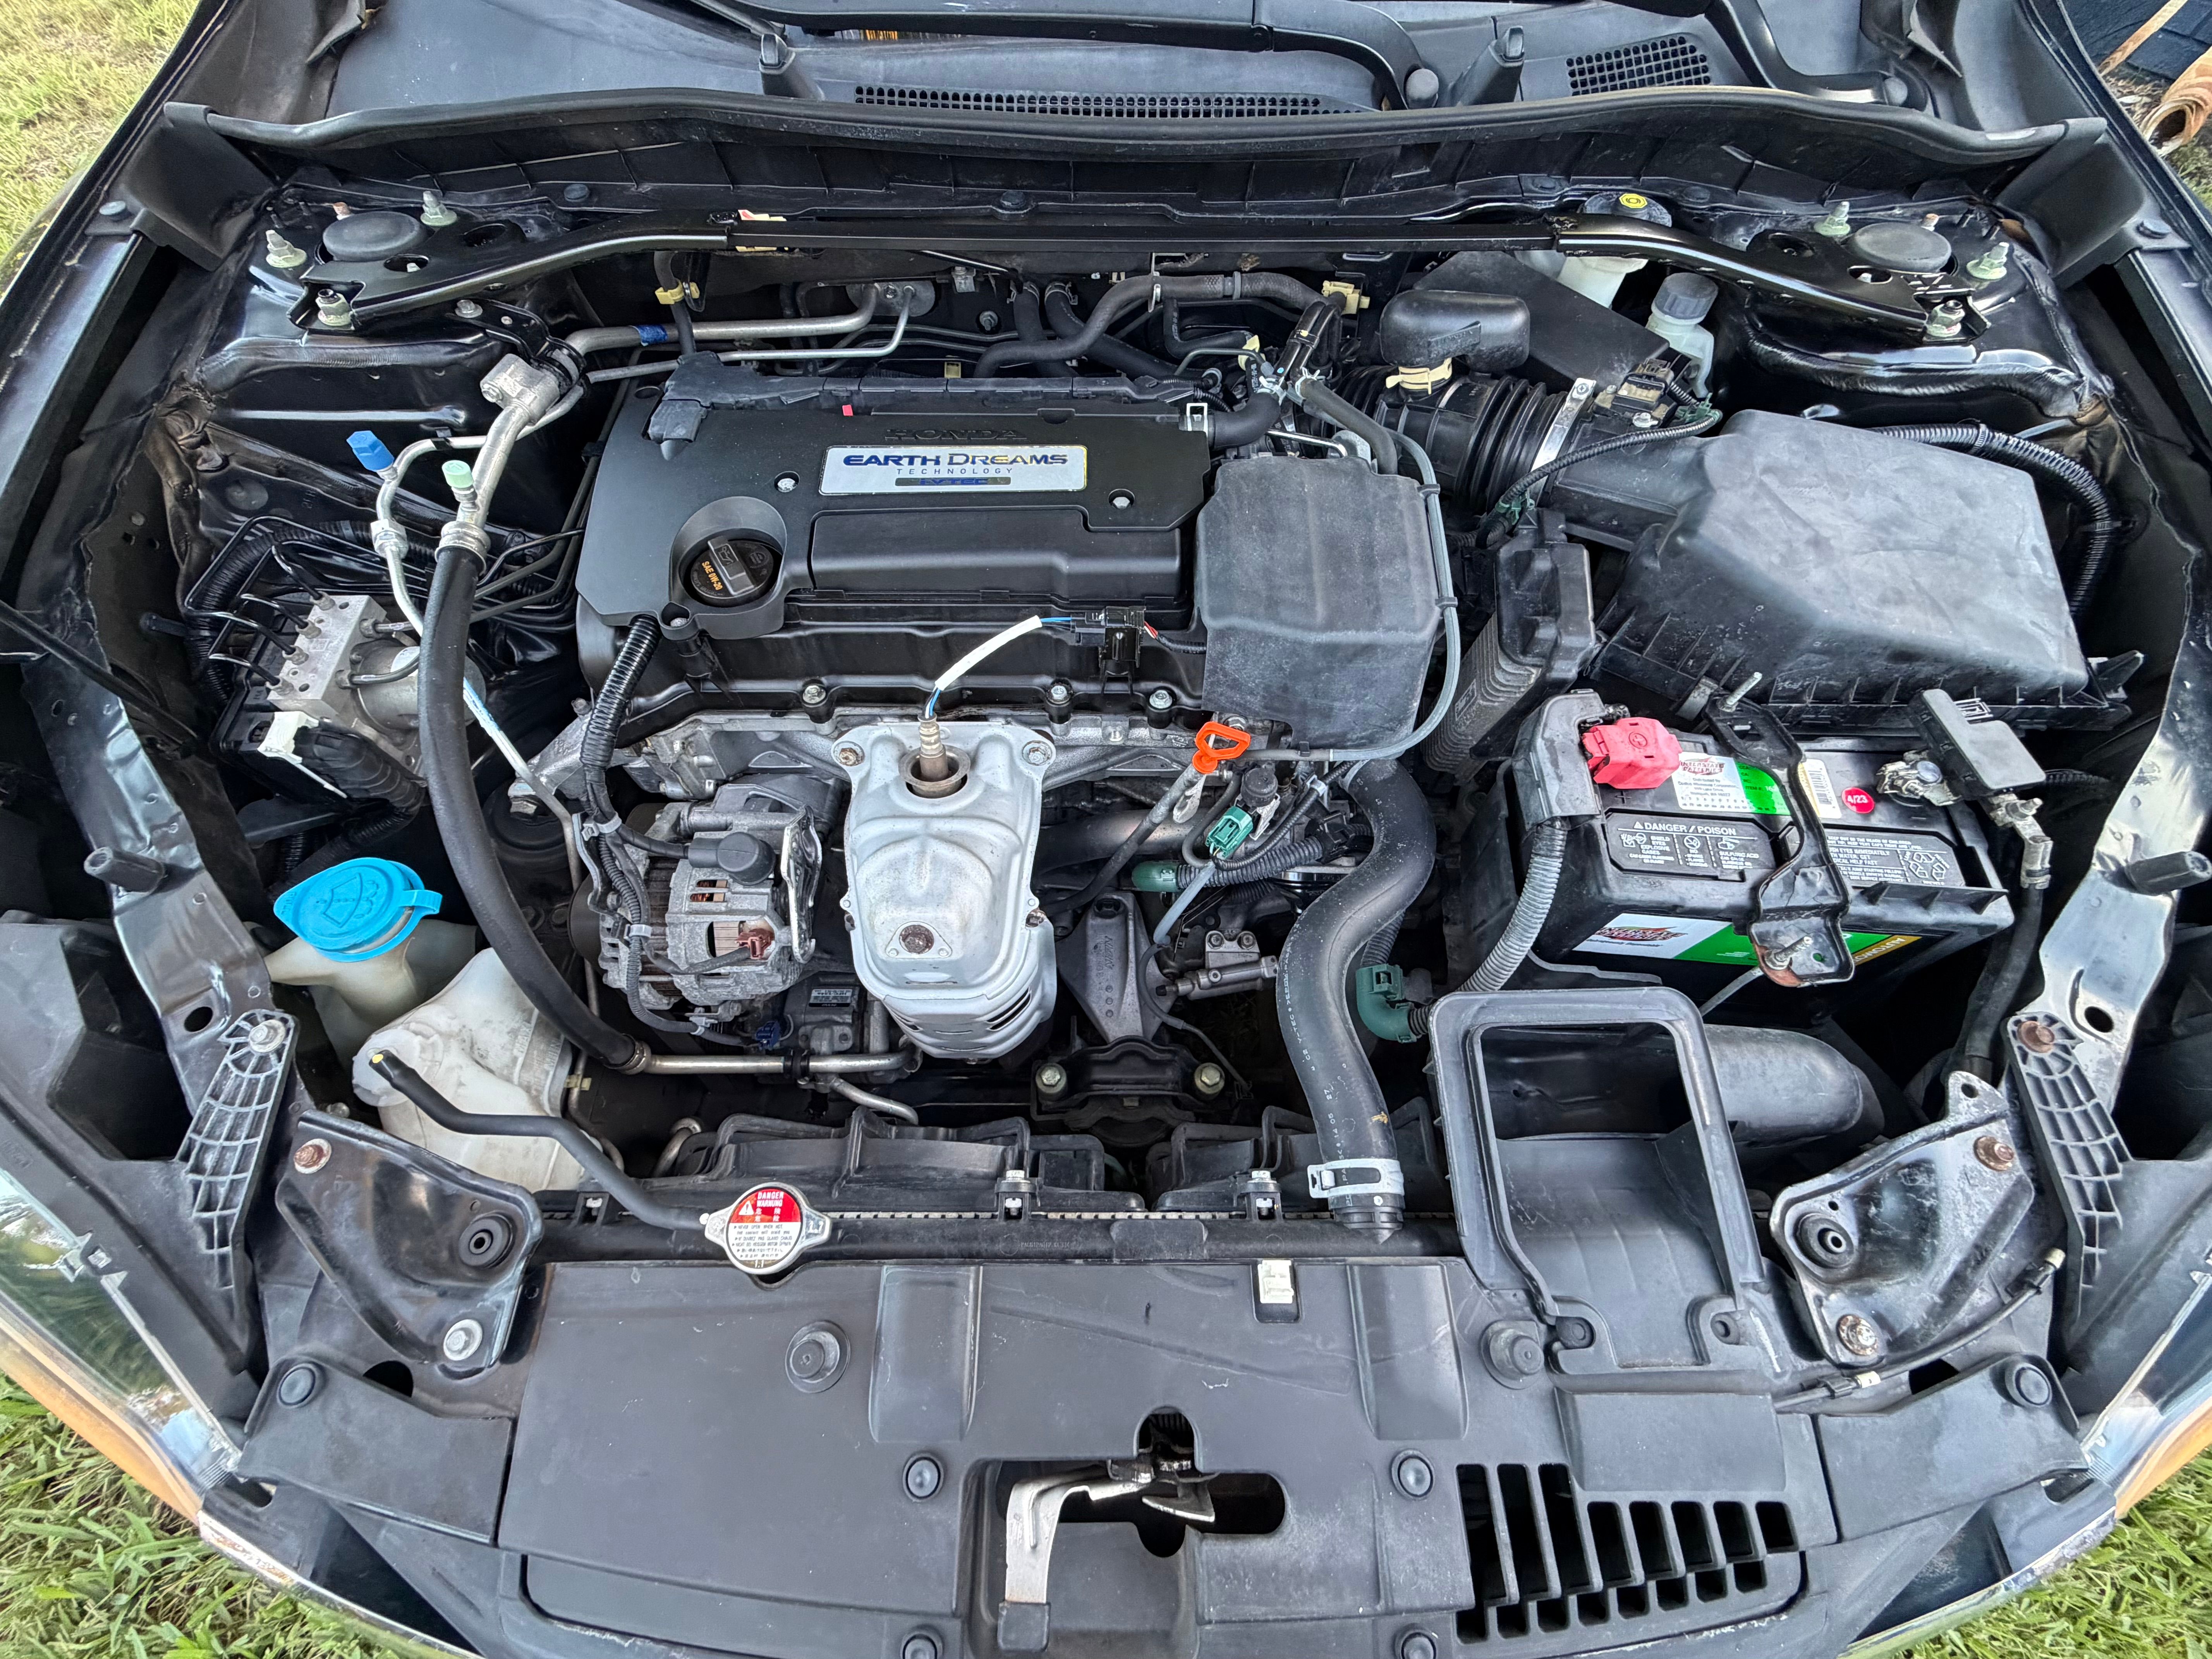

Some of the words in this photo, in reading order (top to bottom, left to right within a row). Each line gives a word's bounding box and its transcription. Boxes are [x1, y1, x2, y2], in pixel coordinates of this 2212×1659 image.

[885, 429, 1027, 440] HONDA
[843, 455, 941, 466] EARTH
[947, 453, 1068, 465] DREAMS
[702, 561, 714, 574] SAE
[708, 573, 723, 591] 0W-20
[1847, 795, 1868, 804] 4/23
[1644, 822, 1687, 832] DANGER
[1697, 826, 1736, 835] POISON
[1289, 1014, 1302, 1044] Y-TEC
[1324, 1089, 1332, 1100] 27
[757, 1191, 784, 1199] DANGER
